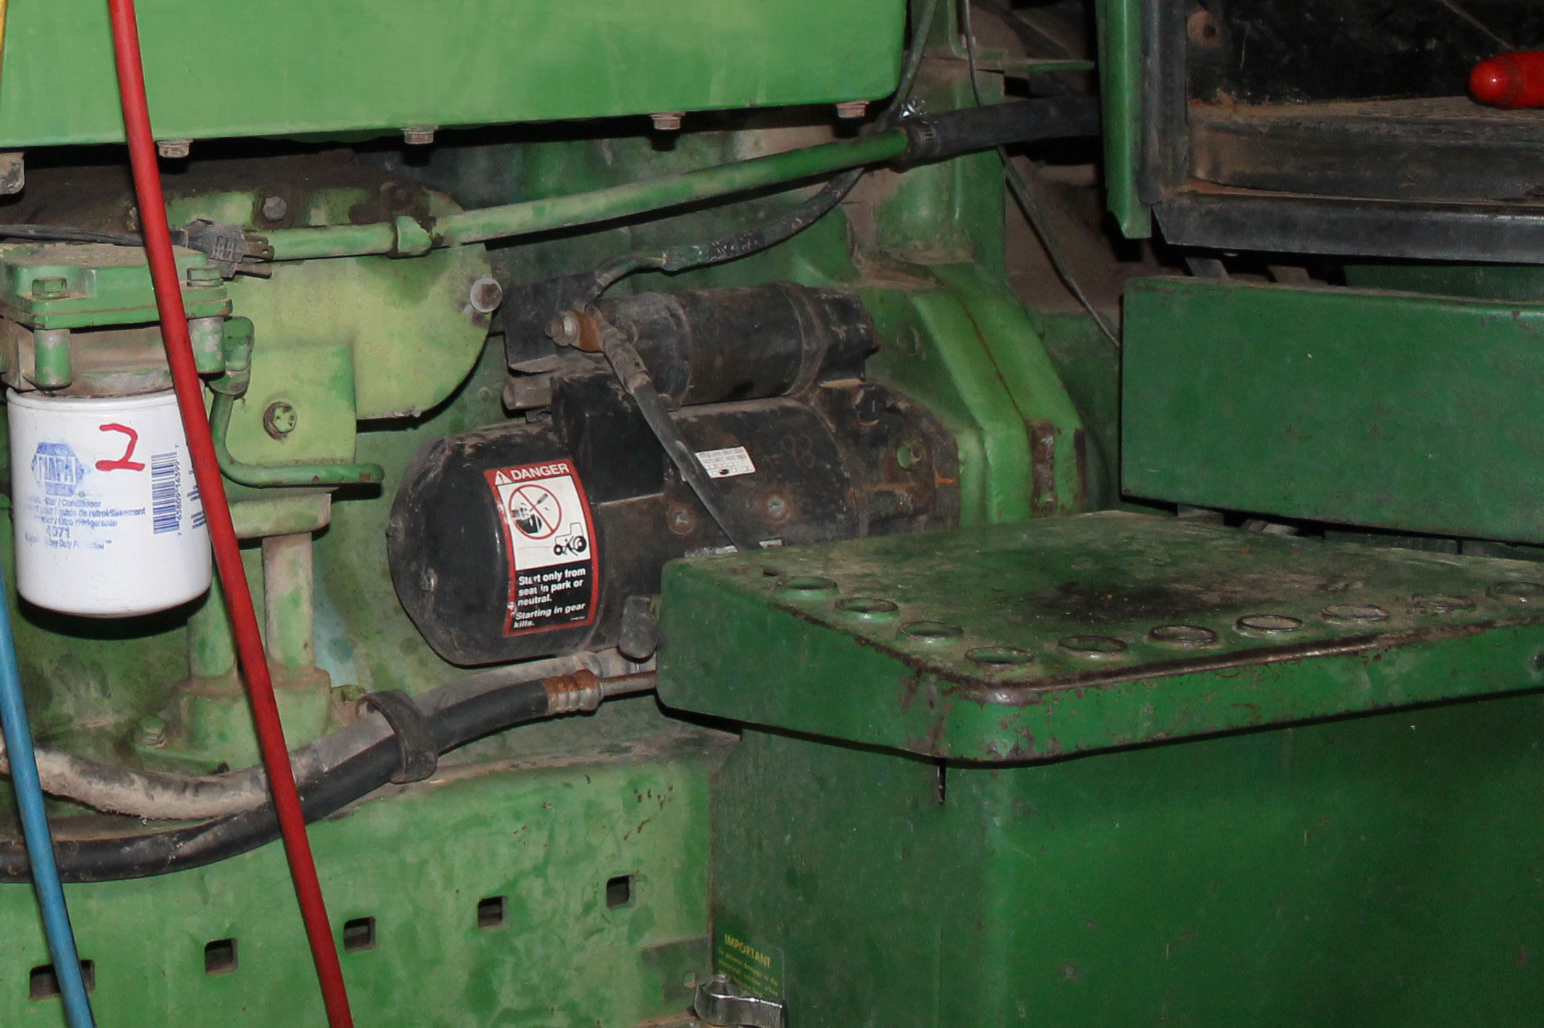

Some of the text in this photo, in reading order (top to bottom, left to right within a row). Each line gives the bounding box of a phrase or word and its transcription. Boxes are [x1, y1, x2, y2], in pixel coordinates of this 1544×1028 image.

[95, 422, 146, 472] 2
[510, 462, 570, 481] DANGER
[518, 568, 586, 586] Start only from
[518, 579, 584, 597] seat in park or
[517, 593, 553, 607] neutral.
[514, 603, 586, 621] Starting in gear
[513, 620, 535, 629] kills.
[724, 933, 772, 968] IMPORTANT
